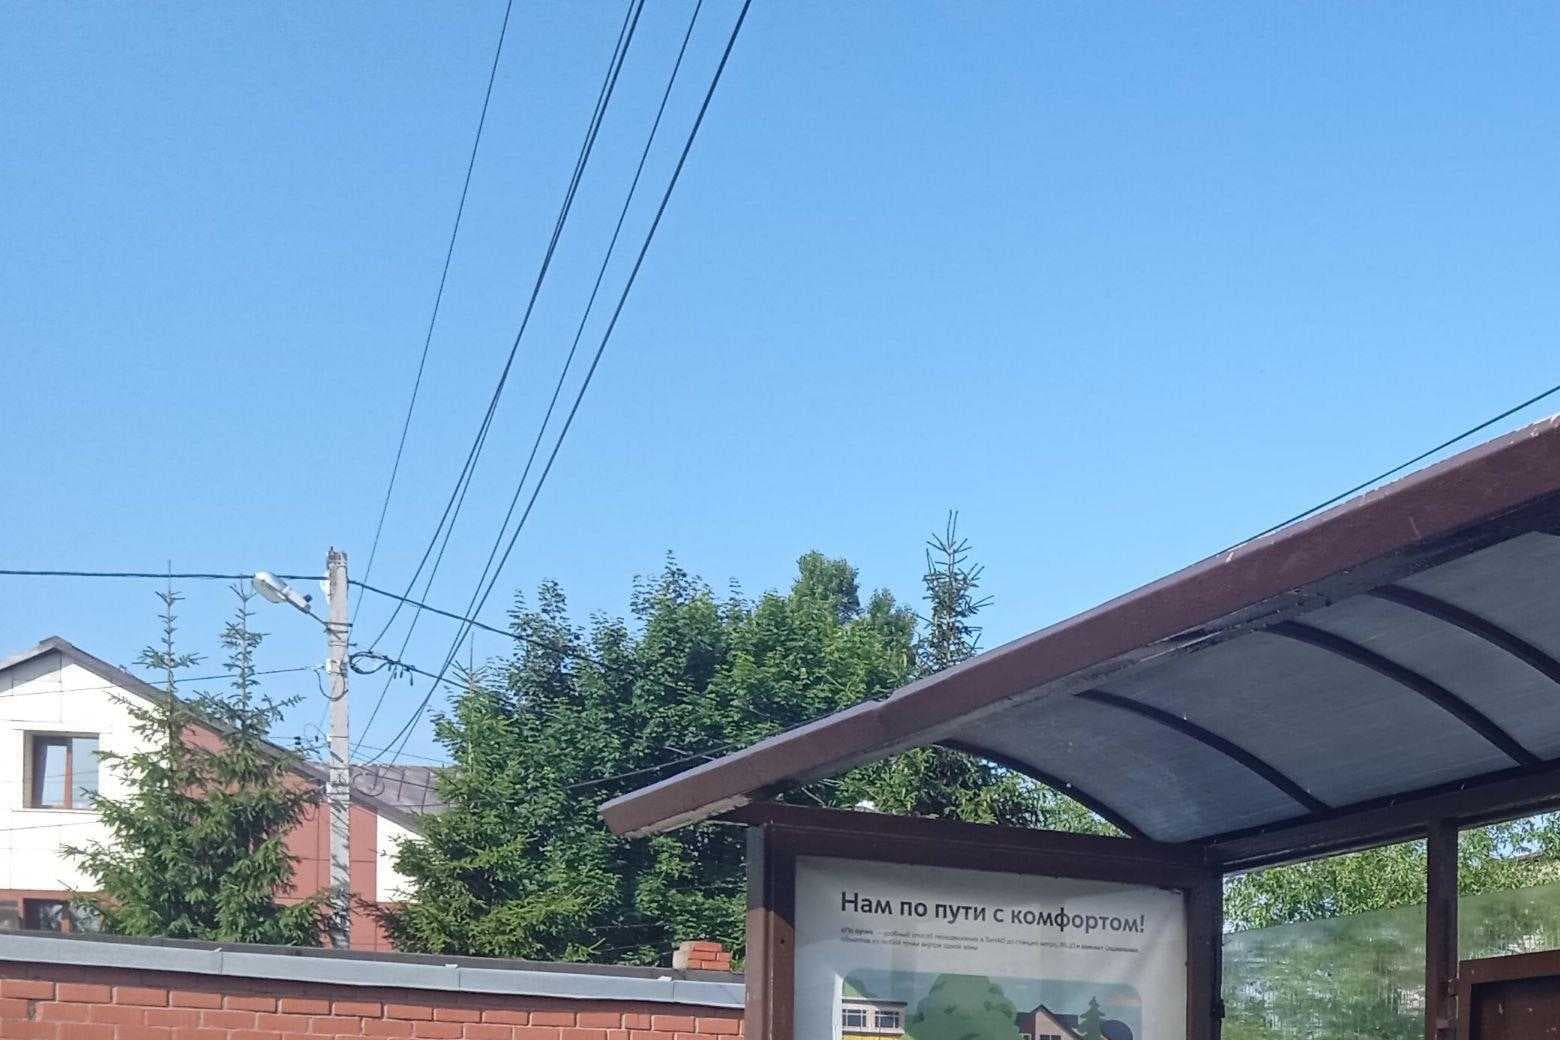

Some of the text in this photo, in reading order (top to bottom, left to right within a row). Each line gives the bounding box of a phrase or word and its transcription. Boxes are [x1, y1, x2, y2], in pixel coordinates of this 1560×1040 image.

[841, 891, 1145, 933] Нам по пути с комфортом!
